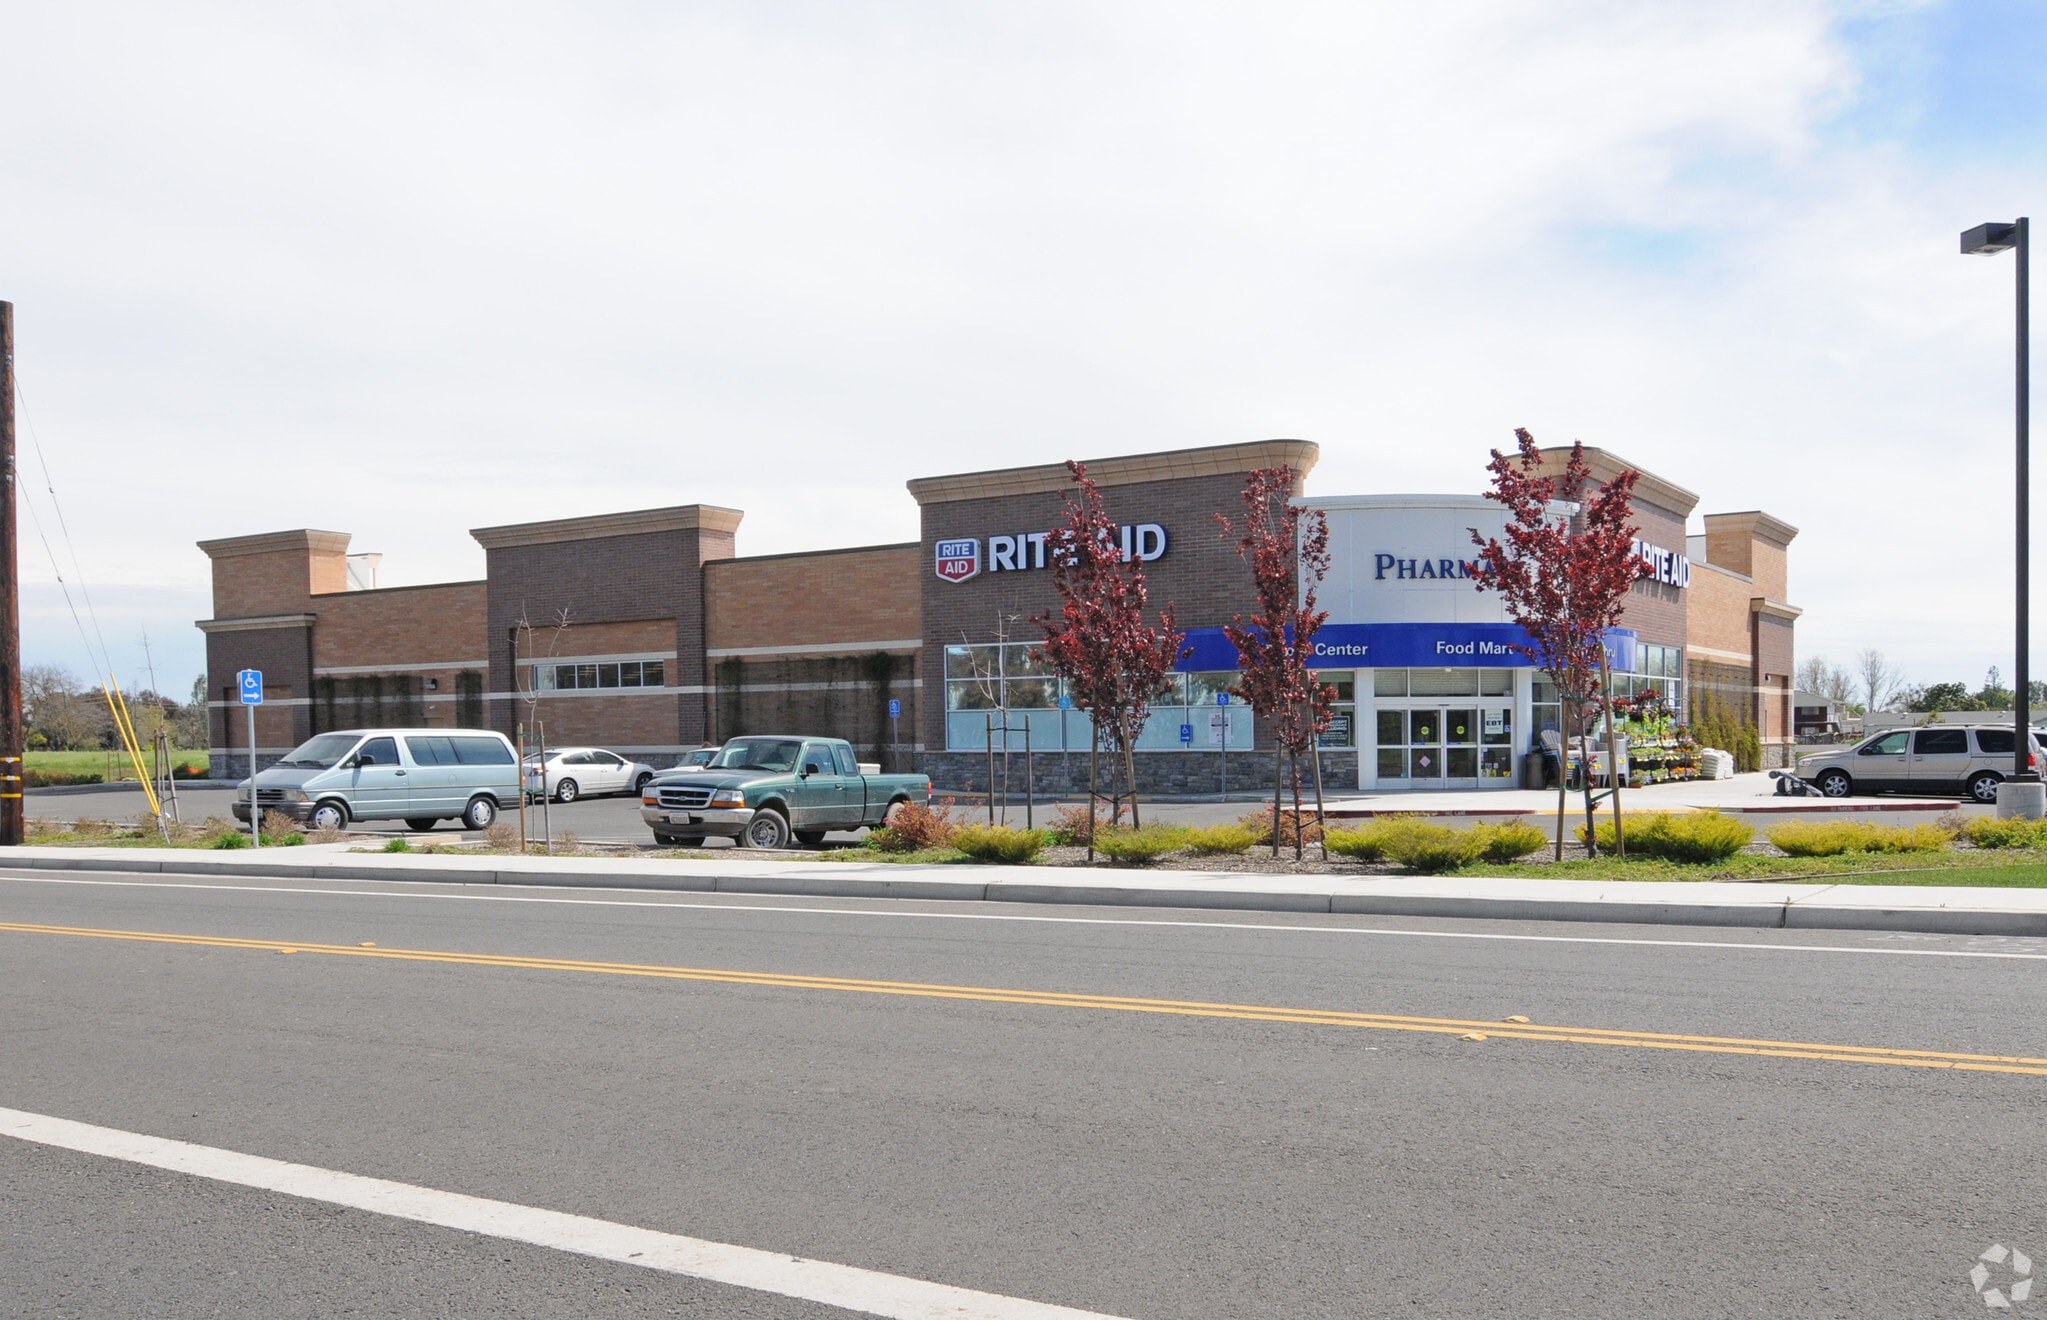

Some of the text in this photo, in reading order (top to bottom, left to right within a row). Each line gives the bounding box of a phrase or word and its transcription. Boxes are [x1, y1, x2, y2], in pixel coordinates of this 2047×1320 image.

[942, 543, 970, 556] RITE
[1095, 523, 1166, 562] ID
[945, 560, 968, 574] AID
[1670, 552, 1690, 588] AID
[1315, 643, 1368, 656] Center
[1436, 641, 1514, 655] Food Mart
